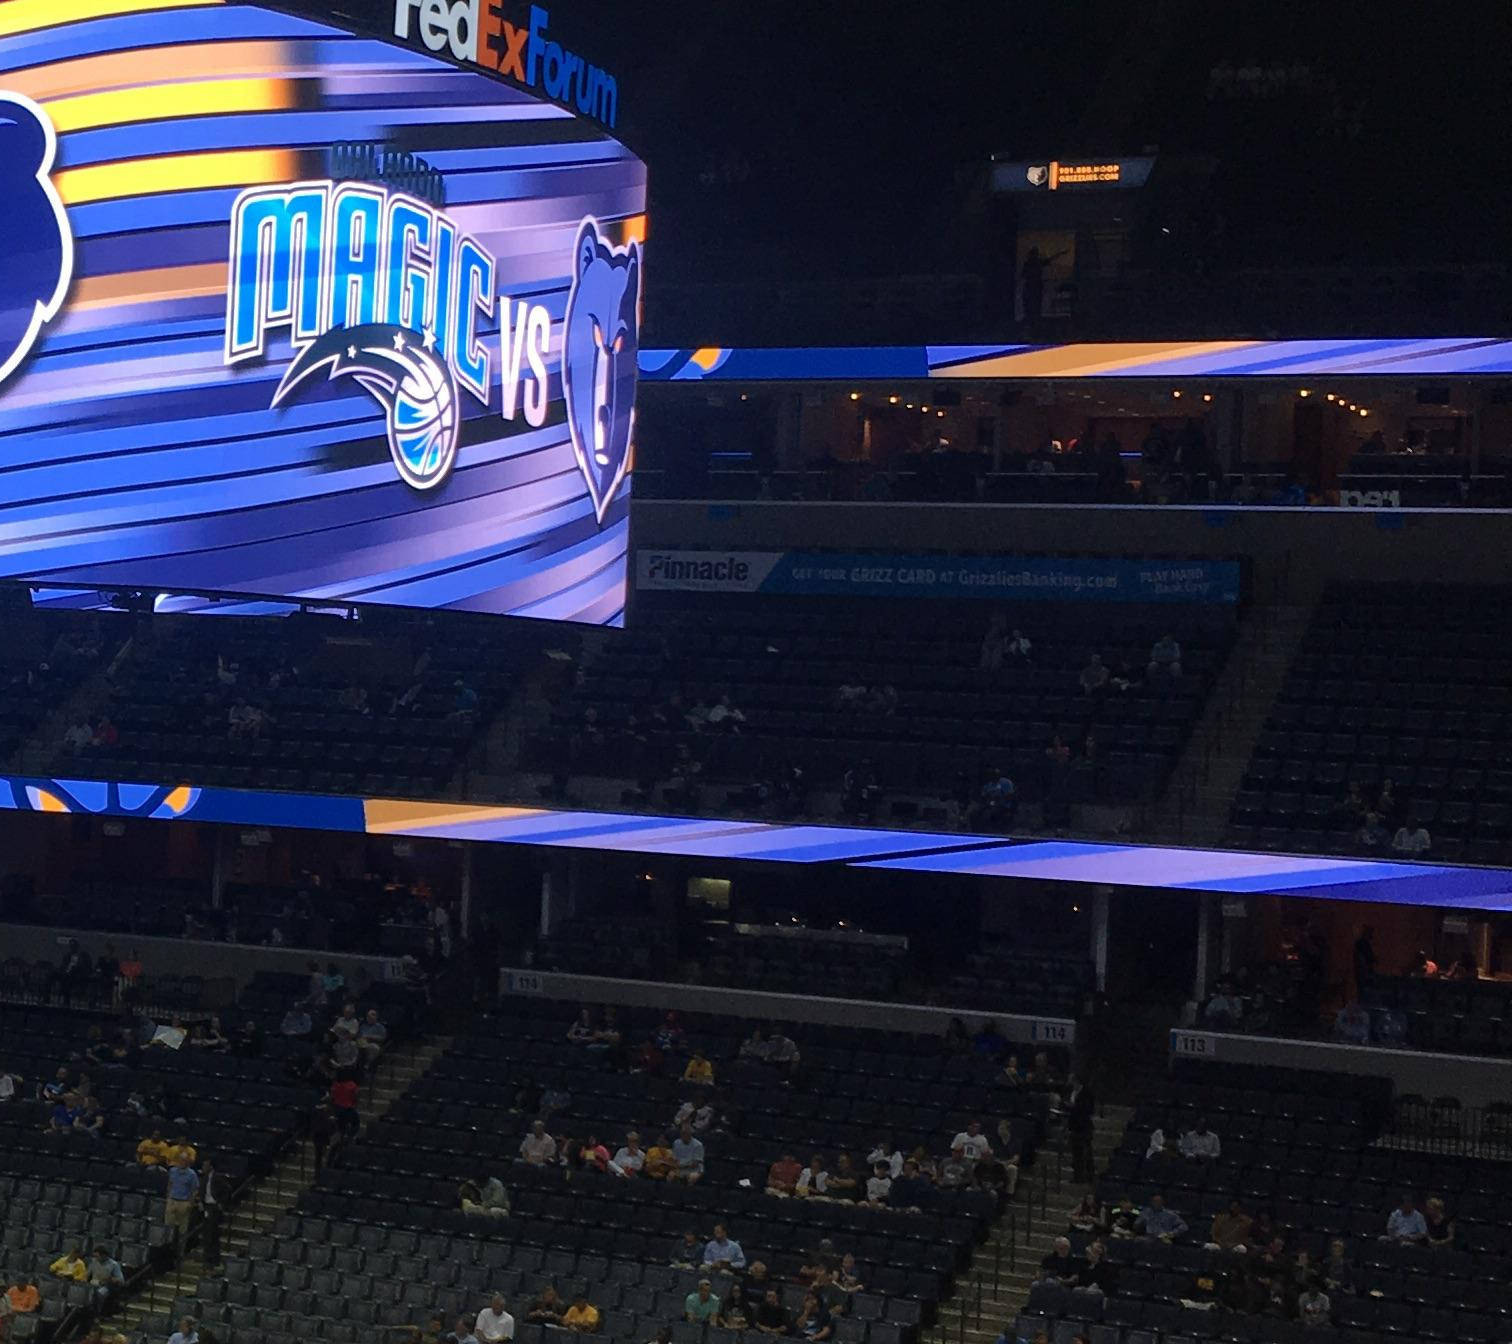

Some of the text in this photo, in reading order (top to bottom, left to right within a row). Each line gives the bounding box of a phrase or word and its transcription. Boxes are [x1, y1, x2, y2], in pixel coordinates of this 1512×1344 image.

[224, 179, 550, 427] MAGIC VS
[649, 555, 749, 581] Pinnacle
[897, 568, 936, 584] CARD
